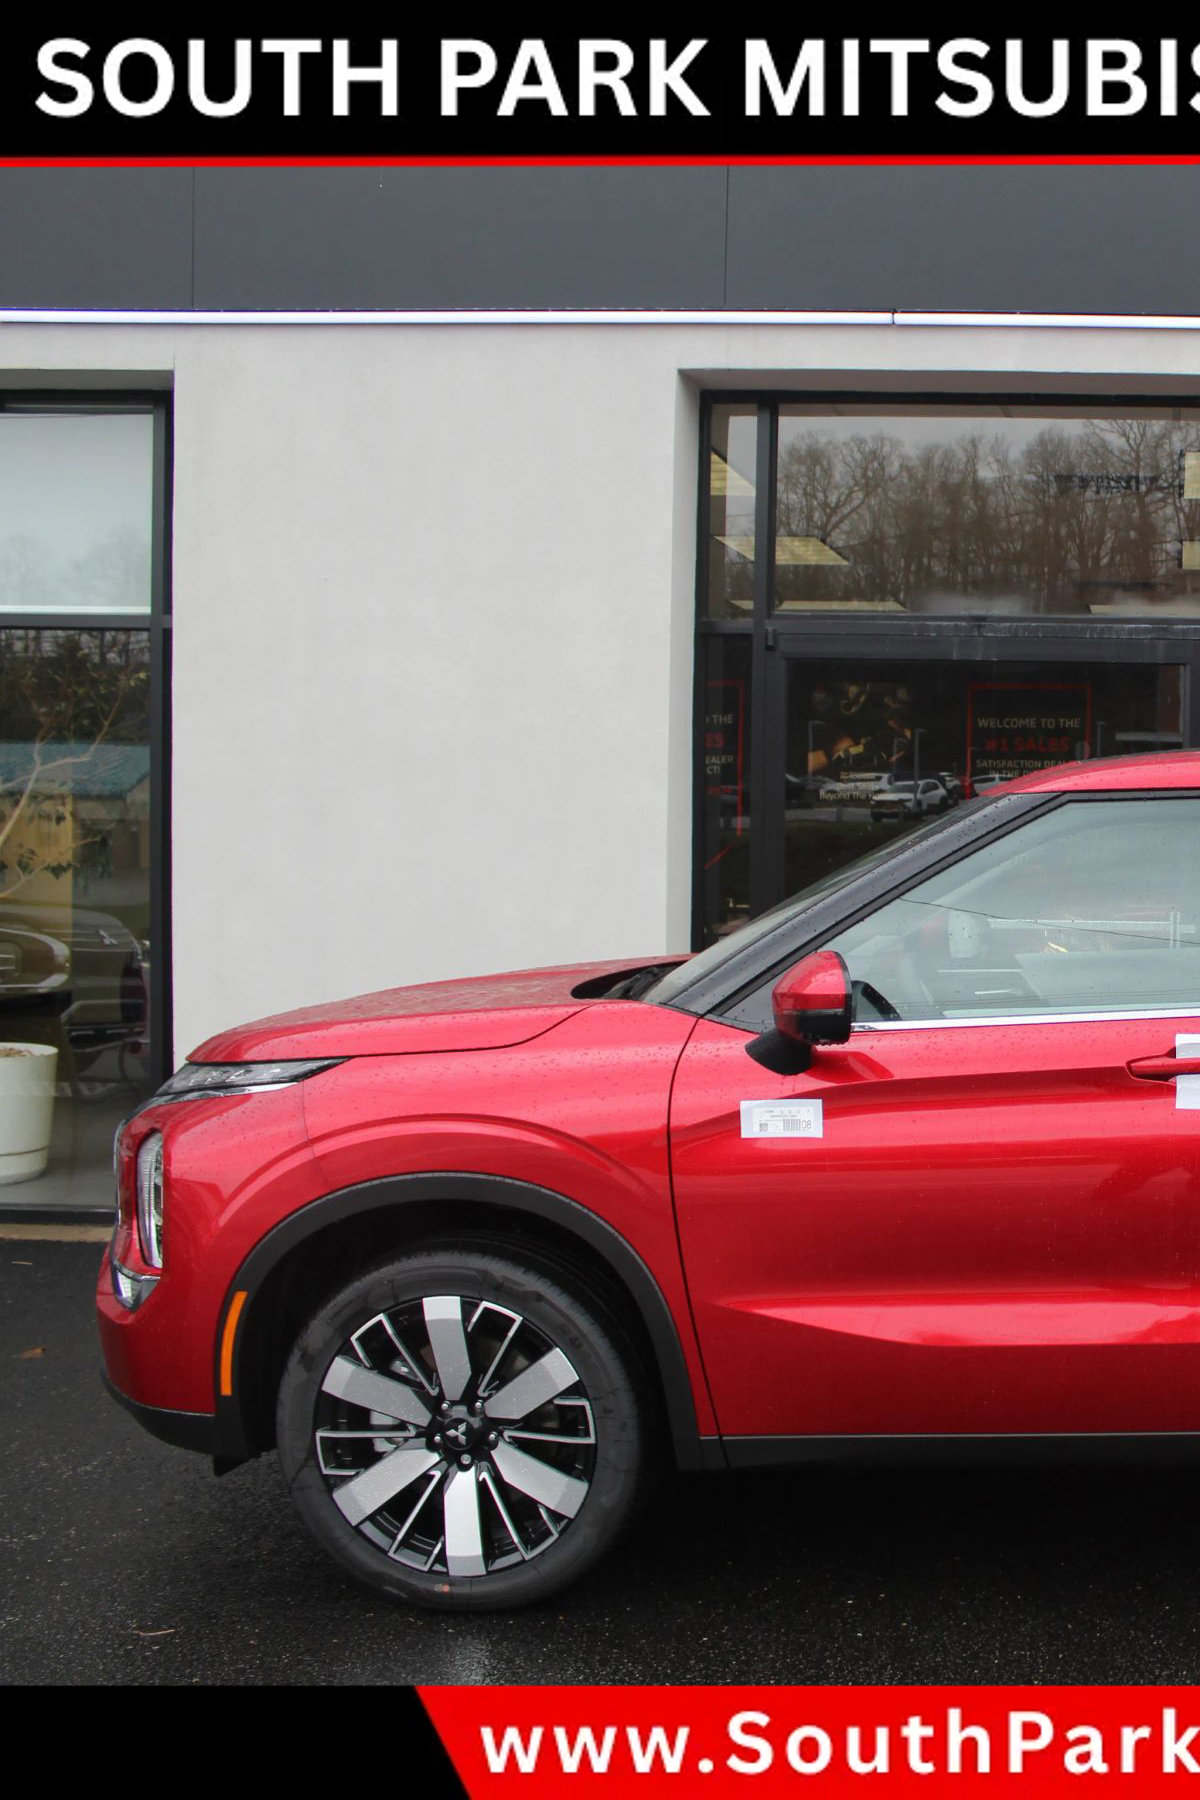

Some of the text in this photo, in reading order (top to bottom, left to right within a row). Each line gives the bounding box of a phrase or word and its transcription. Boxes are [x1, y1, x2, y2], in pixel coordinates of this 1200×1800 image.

[712, 714, 733, 724] THE
[977, 718, 1081, 728] WELCOME TO THE
[1014, 738, 1070, 752] SALES
[975, 760, 1041, 769] SATISFACTION
[820, 791, 850, 800] Beyond
